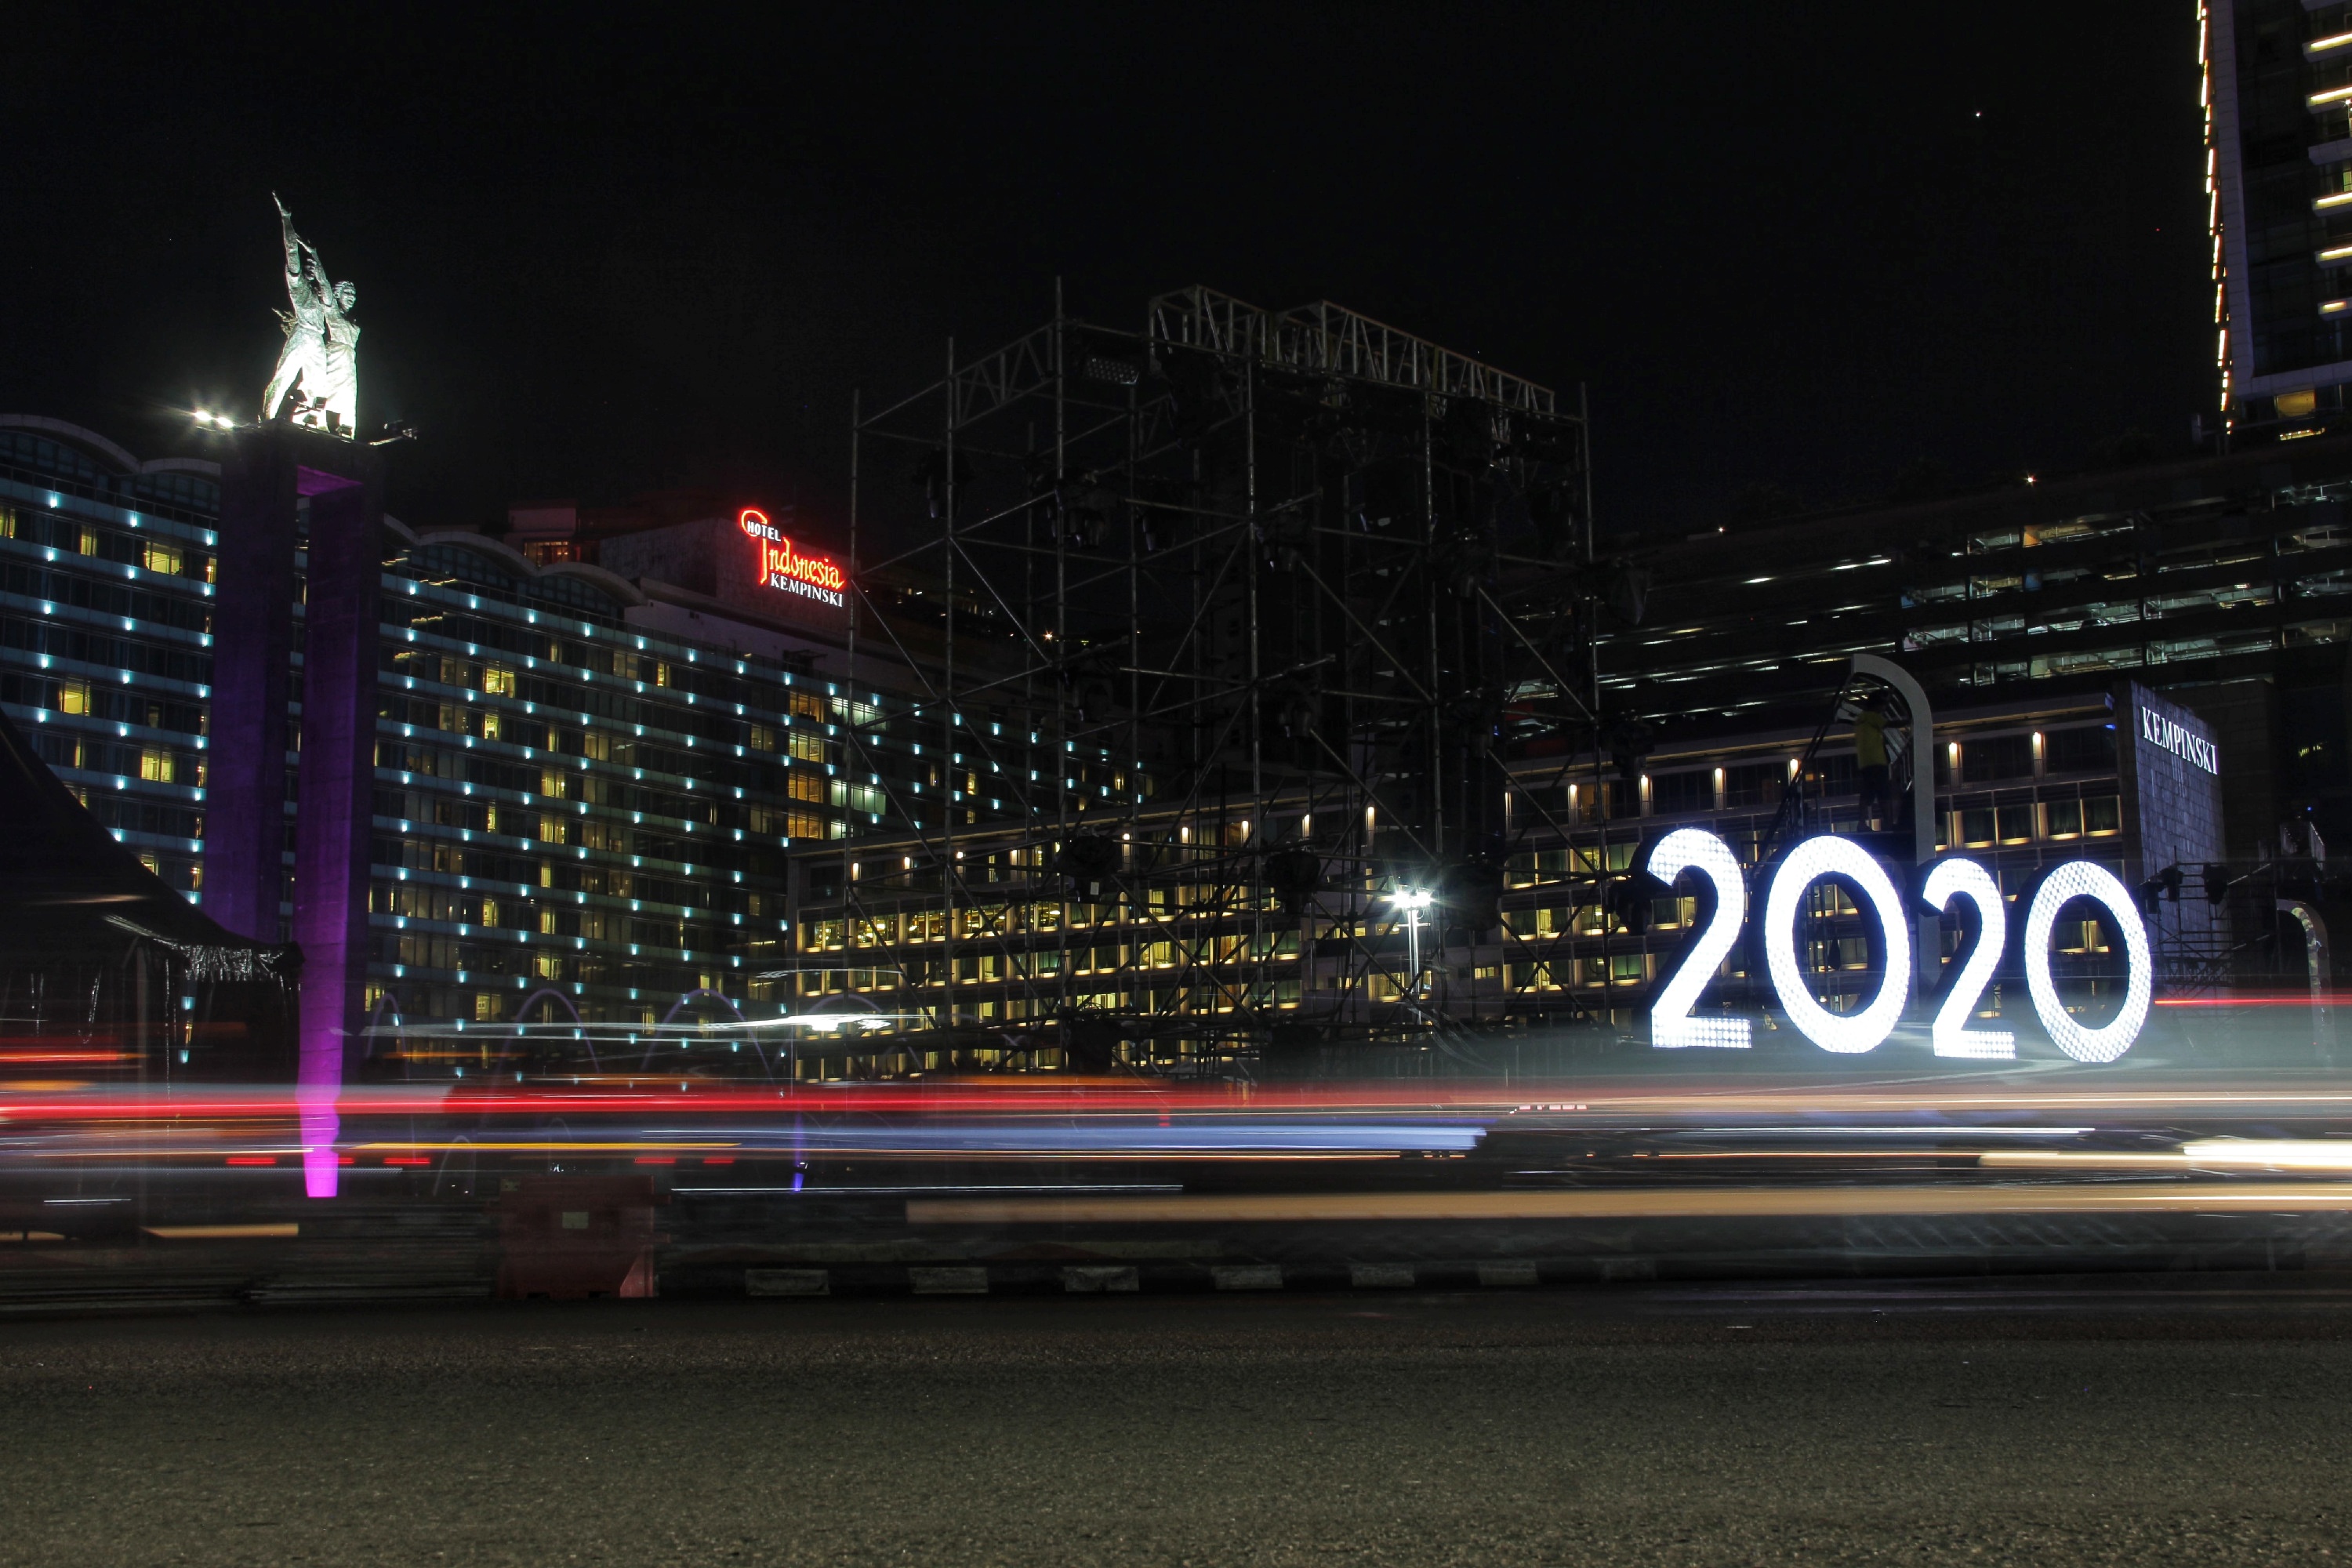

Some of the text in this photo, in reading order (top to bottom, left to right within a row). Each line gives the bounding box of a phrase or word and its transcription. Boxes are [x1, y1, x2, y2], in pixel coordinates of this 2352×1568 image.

[741, 510, 845, 590] Indonesia
[747, 520, 782, 542] HOTEL
[771, 572, 844, 608] KEMPINSKI
[2141, 706, 2218, 775] KEMPINSKI
[1647, 827, 2152, 1064] 2020
